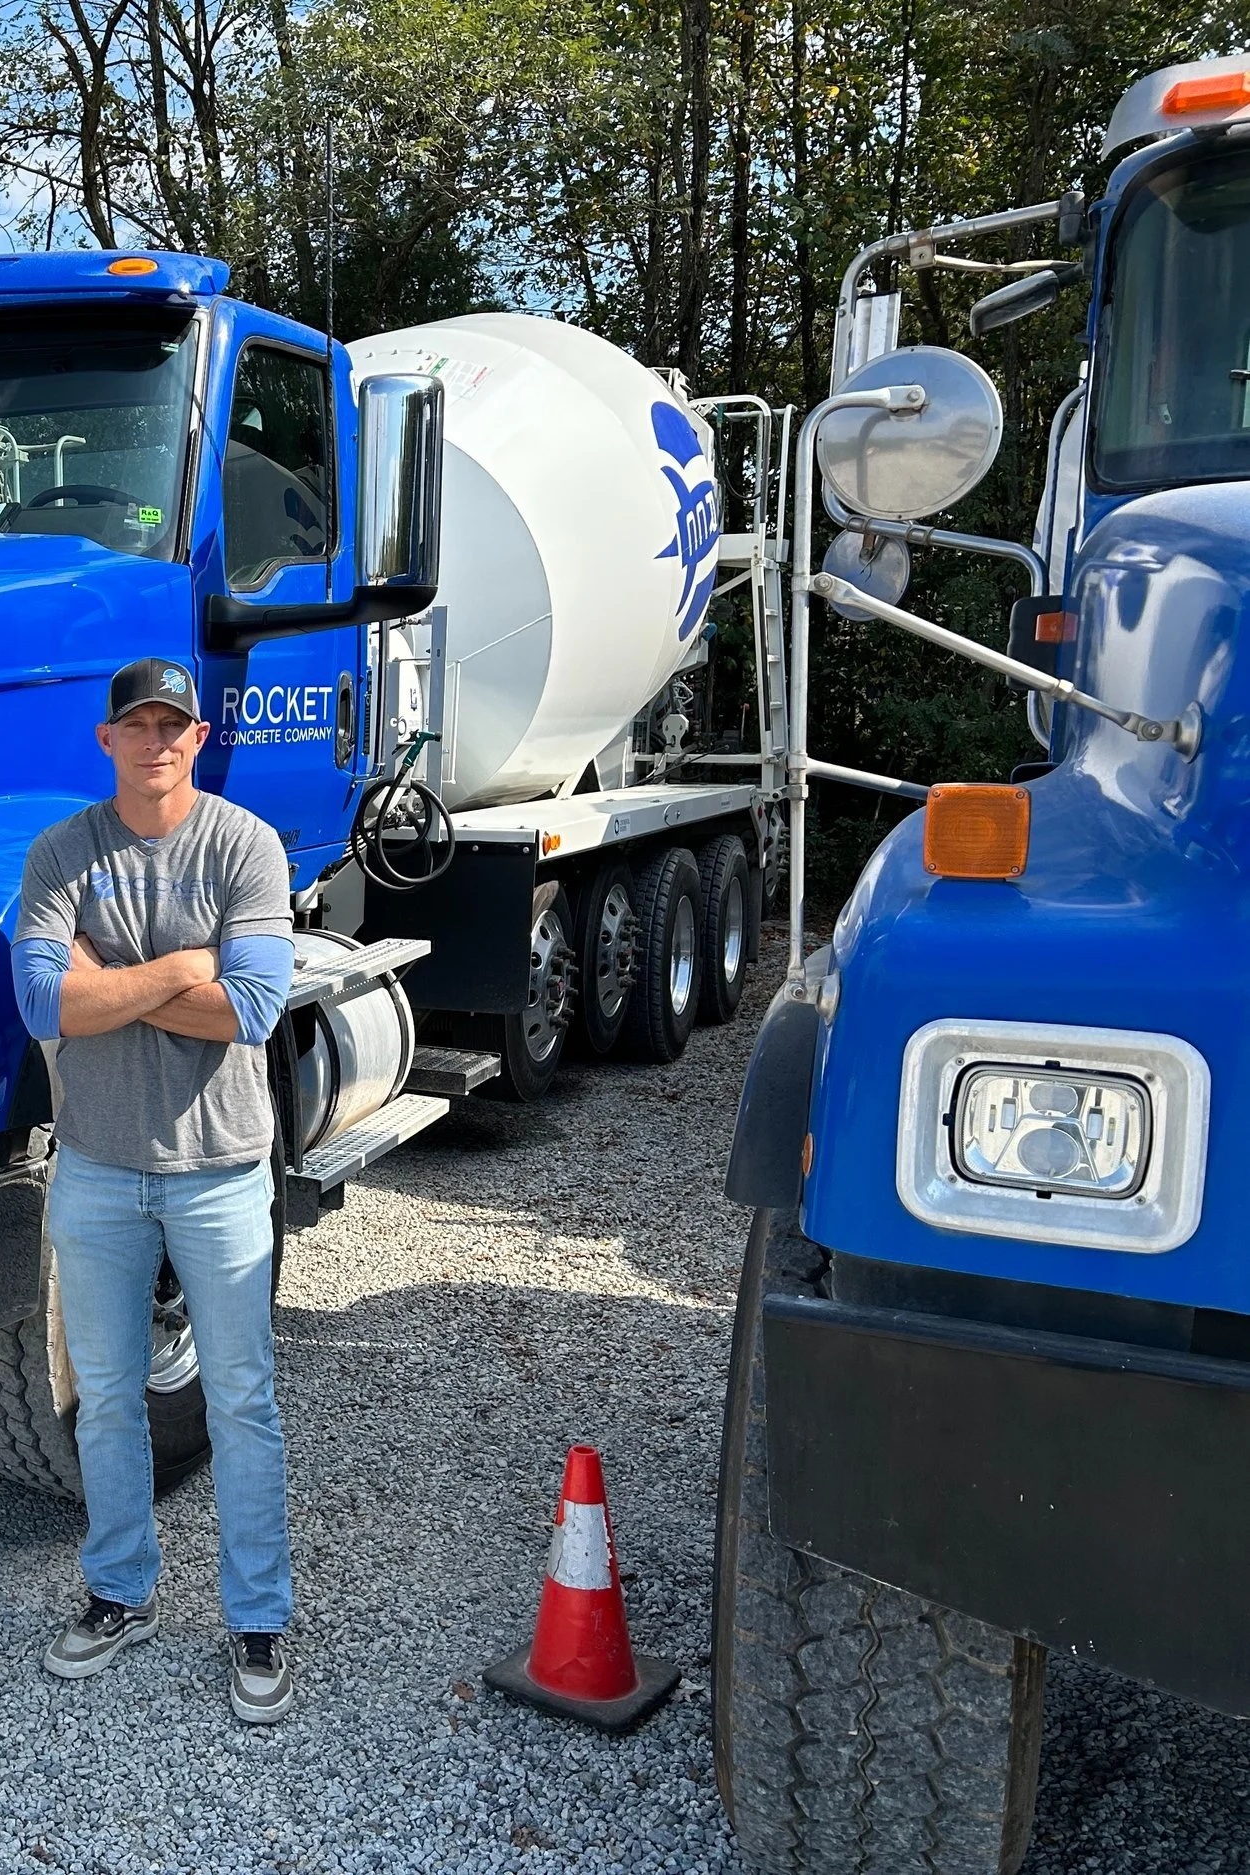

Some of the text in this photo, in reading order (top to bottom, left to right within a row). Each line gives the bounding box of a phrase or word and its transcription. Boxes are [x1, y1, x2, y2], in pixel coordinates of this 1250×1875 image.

[221, 685, 333, 725] ROCKET
[219, 726, 333, 746] CONCRETE COMPANY
